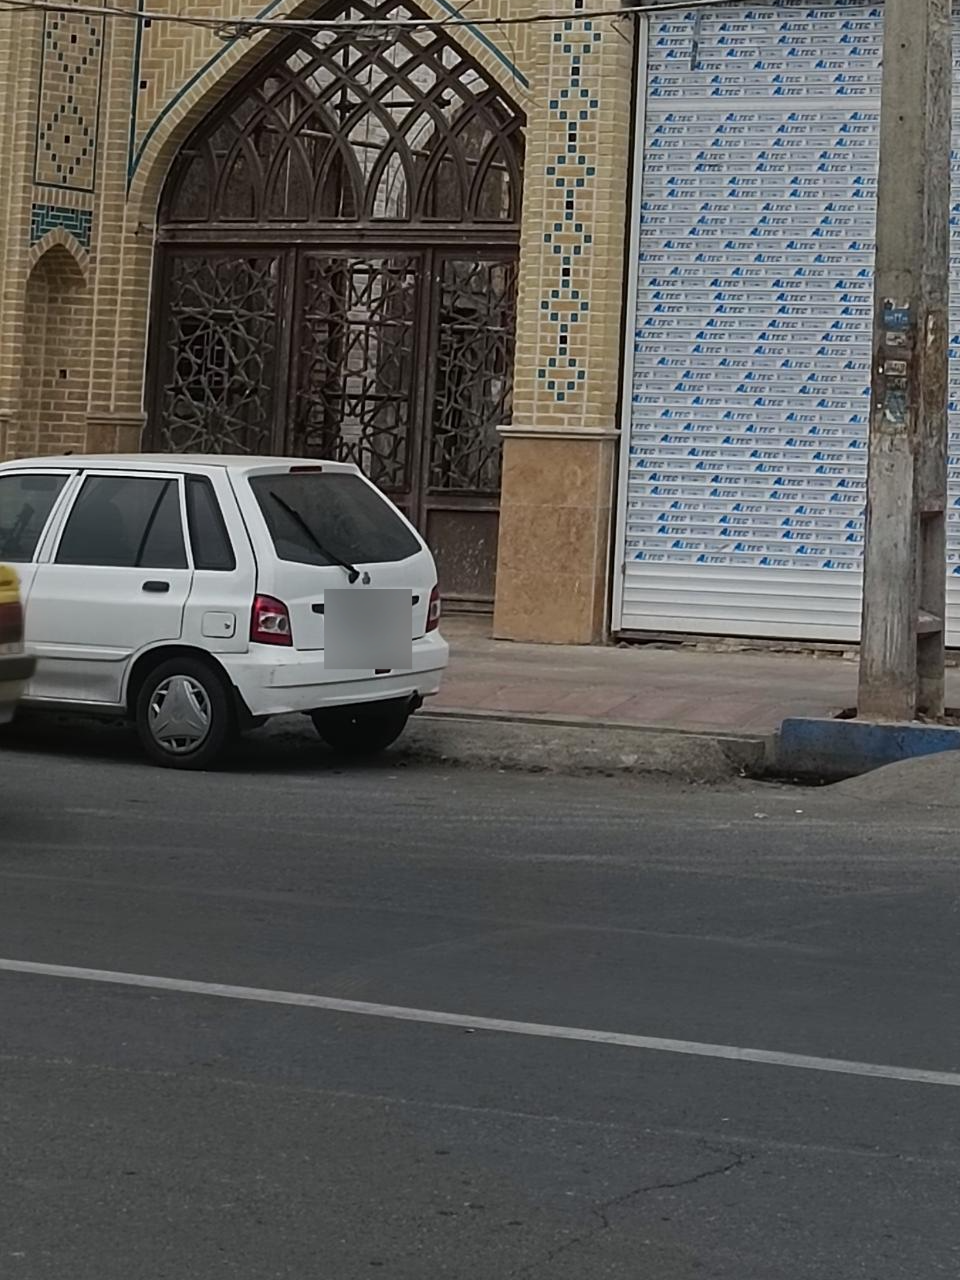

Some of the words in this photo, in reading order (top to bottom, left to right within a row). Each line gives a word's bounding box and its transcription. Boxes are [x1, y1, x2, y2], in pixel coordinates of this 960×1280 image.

[658, 24, 689, 33] ALTEC
[841, 21, 872, 30] ALTEC
[656, 37, 687, 46] ALTEC
[717, 36, 748, 45] ALTEC
[726, 49, 757, 58] ALTEC
[787, 48, 818, 57] ALTEC
[849, 47, 880, 56] ALTEC
[753, 61, 784, 70] ALTEC
[815, 60, 846, 69] ALTEC
[710, 75, 741, 84] ALTEC
[650, 88, 681, 97] ALTEC
[711, 87, 742, 96] ALTEC
[773, 87, 804, 96] ALTEC
[836, 86, 867, 95] ALTEC
[664, 113, 695, 122] ALTEC
[725, 113, 756, 122] ALTEC
[777, 125, 808, 134] ALTEC
[839, 124, 870, 133] ALTEC
[650, 139, 681, 148] ALTEC
[711, 138, 742, 147] ALTEC
[772, 138, 803, 147] ALTEC
[835, 138, 866, 147] ALTEC
[819, 151, 850, 160] ALTEC
[755, 163, 786, 172] ALTEC
[817, 163, 848, 172] ALTEC
[667, 177, 698, 186] ALTEC
[728, 177, 759, 186] ALTEC
[667, 189, 698, 198] ALTEC
[728, 189, 759, 198] ALTEC
[789, 189, 820, 198] ALTEC
[688, 227, 719, 236] ALTEC
[749, 228, 780, 237] ALTEC
[812, 228, 843, 237] ALTEC
[663, 240, 694, 249] ALTEC
[724, 241, 755, 250] ALTEC
[786, 241, 817, 250] ALTEC
[753, 254, 784, 263] ALTEC
[813, 254, 844, 263] ALTEC
[794, 268, 825, 277] ALTEC
[648, 278, 679, 287] ALTEC
[710, 279, 741, 288] ALTEC
[772, 280, 803, 289] ALTEC
[835, 280, 866, 289] ALTEC
[652, 291, 683, 300] ALTEC
[714, 292, 745, 301] ALTEC
[776, 293, 807, 302] ALTEC
[840, 294, 871, 303] ALTEC
[653, 304, 684, 313] ALTEC
[715, 305, 746, 314] ALTEC
[777, 306, 808, 315] ALTEC
[841, 307, 872, 316] ALTEC
[644, 318, 675, 327] ALTEC
[768, 320, 799, 329] ALTEC
[831, 321, 862, 330] ALTEC
[695, 331, 726, 340] ALTEC
[758, 332, 789, 341] ALTEC
[821, 333, 852, 342] ALTEC
[692, 345, 723, 354] ALTEC
[754, 346, 785, 355] ALTEC
[817, 347, 848, 356] ALTEC
[657, 357, 688, 366] ALTEC
[682, 371, 713, 380] ALTEC
[744, 372, 775, 381] ALTEC
[674, 383, 705, 392] ALTEC
[736, 384, 767, 393] ALTEC
[798, 386, 829, 395] ALTEC
[692, 396, 723, 405] ALTEC
[754, 398, 785, 407] ALTEC
[817, 399, 848, 408] ALTEC
[723, 411, 754, 420] ALTEC
[683, 423, 714, 432] ALTEC
[745, 425, 776, 434] ALTEC
[808, 426, 839, 435] ALTEC
[660, 435, 691, 444] ALTEC
[722, 436, 753, 445] ALTEC
[785, 438, 816, 447] ALTEC
[687, 448, 718, 457] ALTEC
[750, 450, 781, 459] ALTEC
[813, 452, 844, 461] ALTEC
[635, 460, 666, 469] ALTEC
[754, 464, 785, 473] ALTEC
[815, 466, 846, 475] ALTEC
[649, 473, 680, 482] ALTEC
[711, 475, 742, 484] ALTEC
[773, 477, 804, 486] ALTEC
[649, 487, 680, 496] ALTEC
[709, 489, 740, 498] ALTEC
[769, 491, 800, 500] ALTEC
[830, 493, 861, 502] ALTEC
[670, 501, 701, 510] ALTEC
[732, 503, 763, 512] ALTEC
[795, 506, 826, 515] ALTEC
[657, 513, 688, 522] ALTEC
[719, 516, 750, 525] ALTEC
[781, 518, 812, 527] ALTEC
[657, 526, 688, 535] ALTEC
[719, 528, 750, 537] ALTEC
[782, 531, 813, 540] ALTEC
[672, 540, 703, 549] ALTEC
[733, 543, 764, 552] ALTEC
[796, 546, 827, 555] ALTEC
[634, 552, 665, 561] ALTEC
[759, 557, 790, 566] ALTEC
[823, 560, 854, 569] ALTEC
